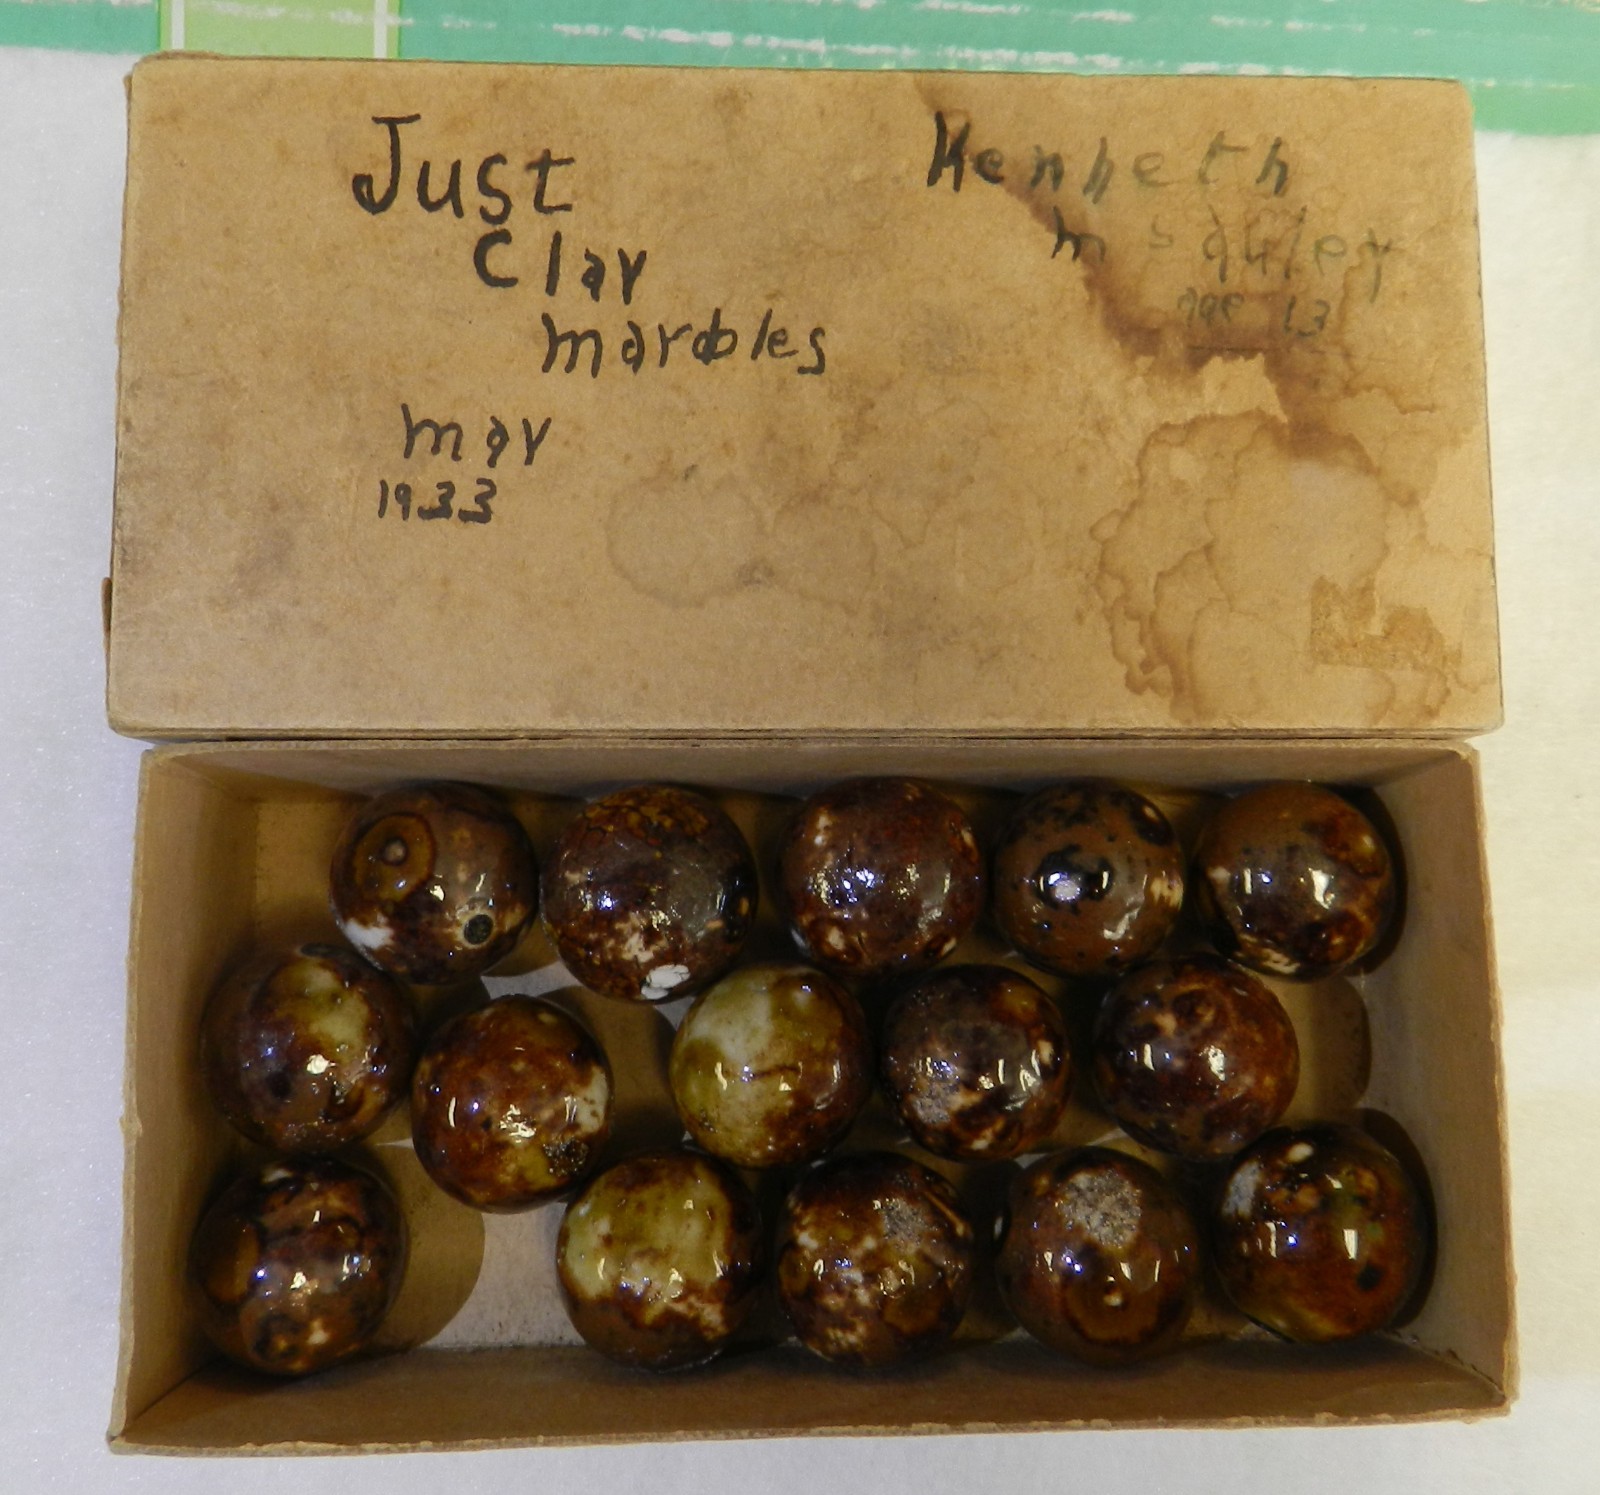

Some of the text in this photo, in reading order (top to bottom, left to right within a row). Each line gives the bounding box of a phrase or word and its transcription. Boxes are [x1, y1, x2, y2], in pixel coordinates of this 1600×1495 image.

[352, 113, 576, 225] Just
[925, 110, 1289, 203] Kenneth
[472, 229, 648, 305] Clay
[541, 308, 827, 379] marbles
[377, 477, 498, 524] 1933
